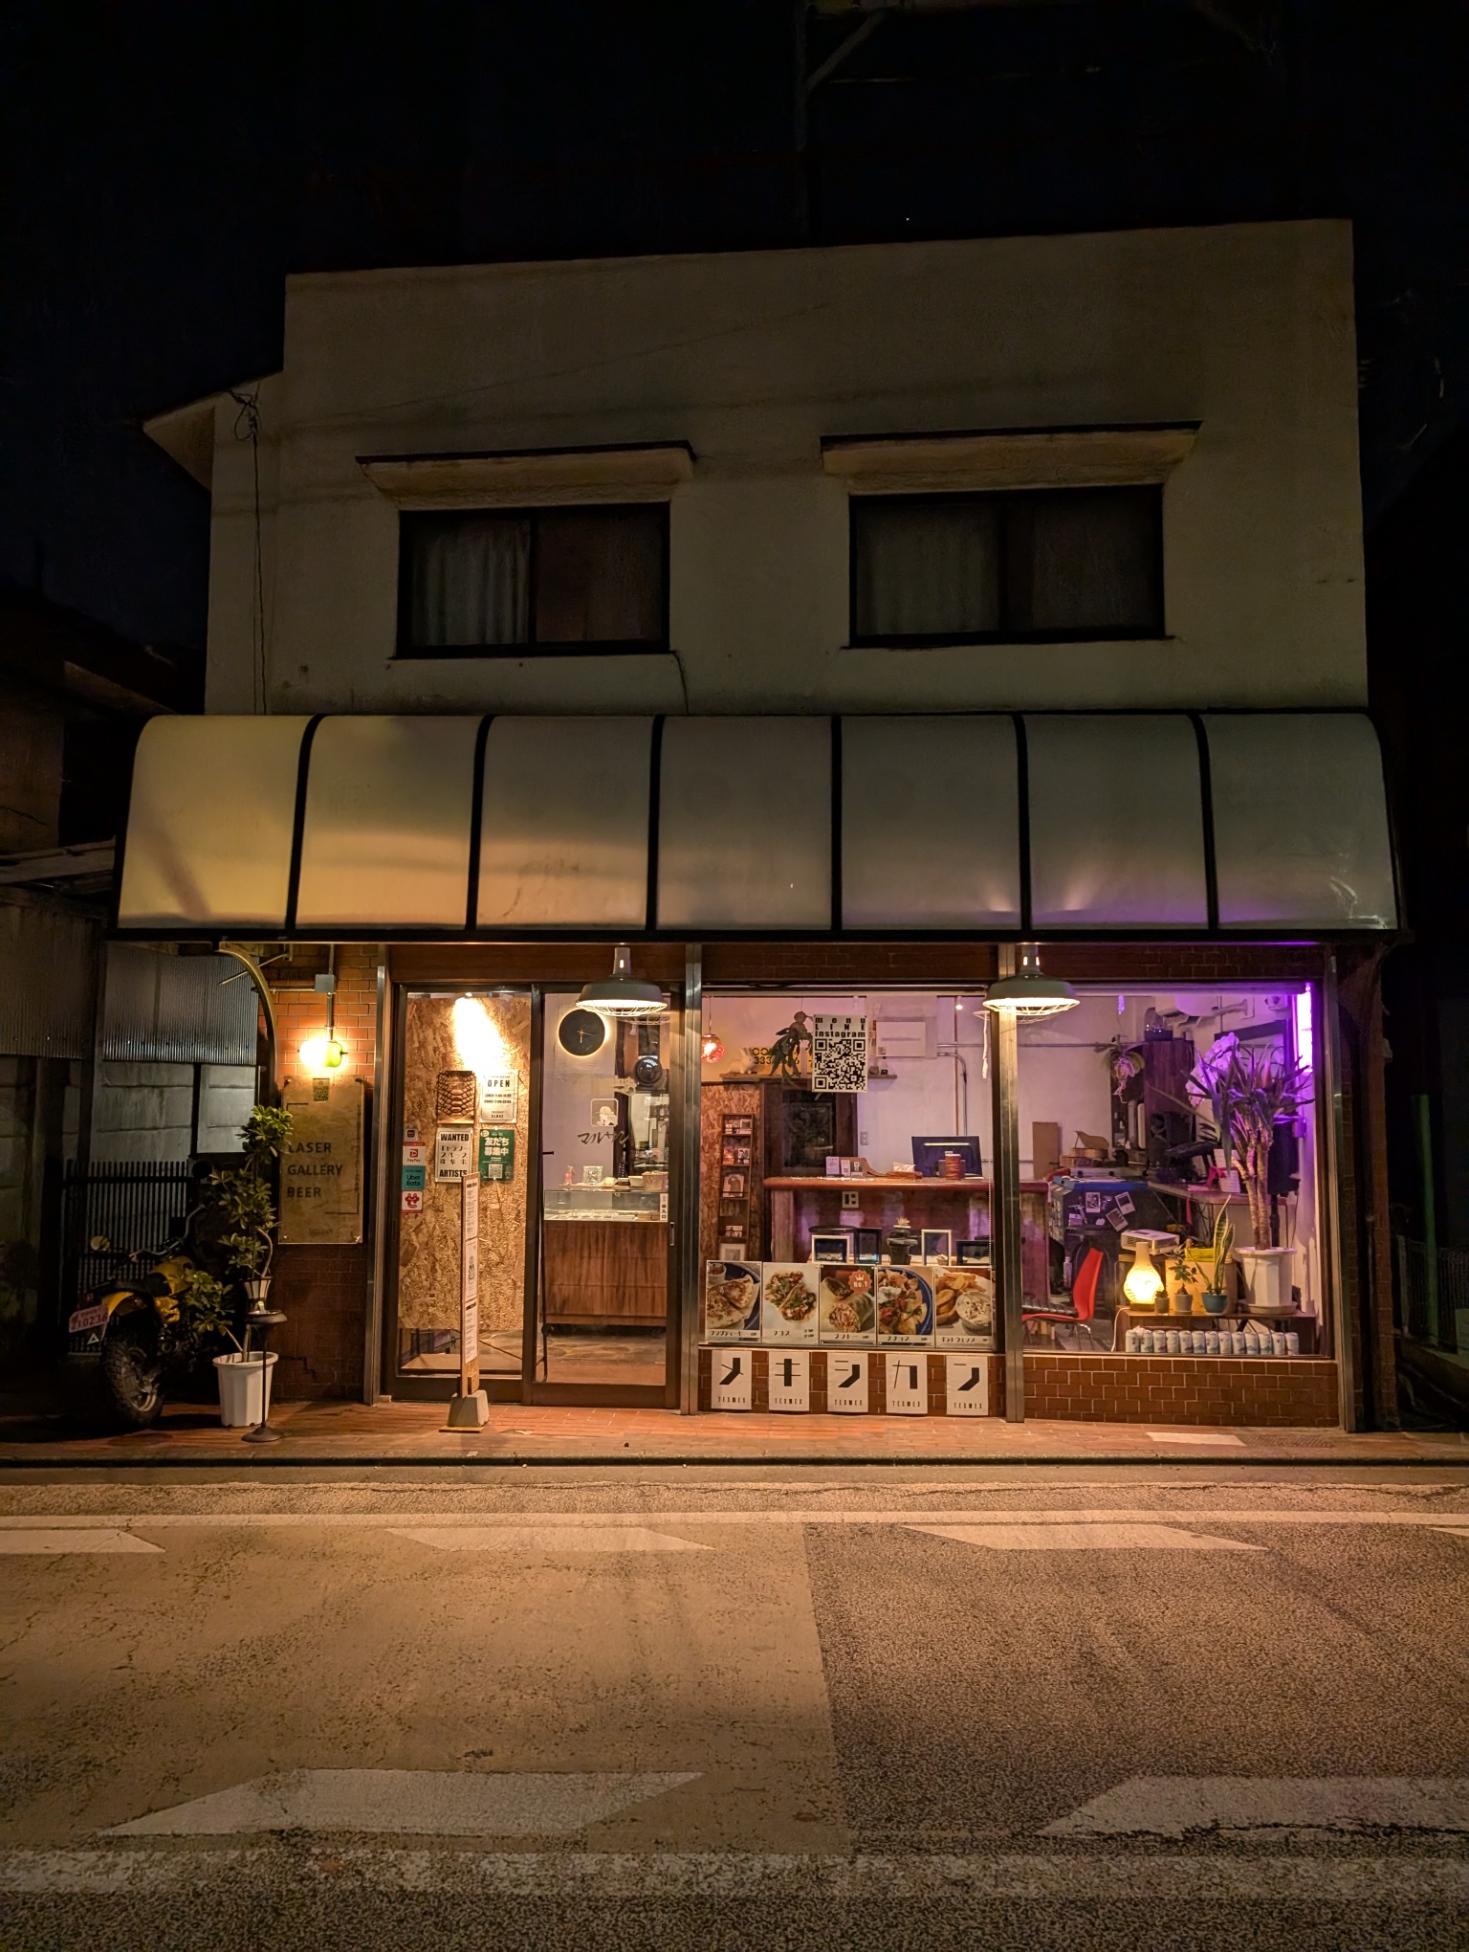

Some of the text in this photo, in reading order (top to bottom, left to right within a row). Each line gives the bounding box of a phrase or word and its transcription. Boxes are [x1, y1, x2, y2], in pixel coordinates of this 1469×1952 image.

[487, 1079, 511, 1088] OPEN
[440, 1133, 470, 1142] WANTED
[484, 1137, 510, 1147] 友だち
[288, 1142, 332, 1153] LASER
[287, 1164, 344, 1176] GALLERY
[440, 1169, 468, 1178] ARTISTS
[287, 1186, 322, 1198] BEER
